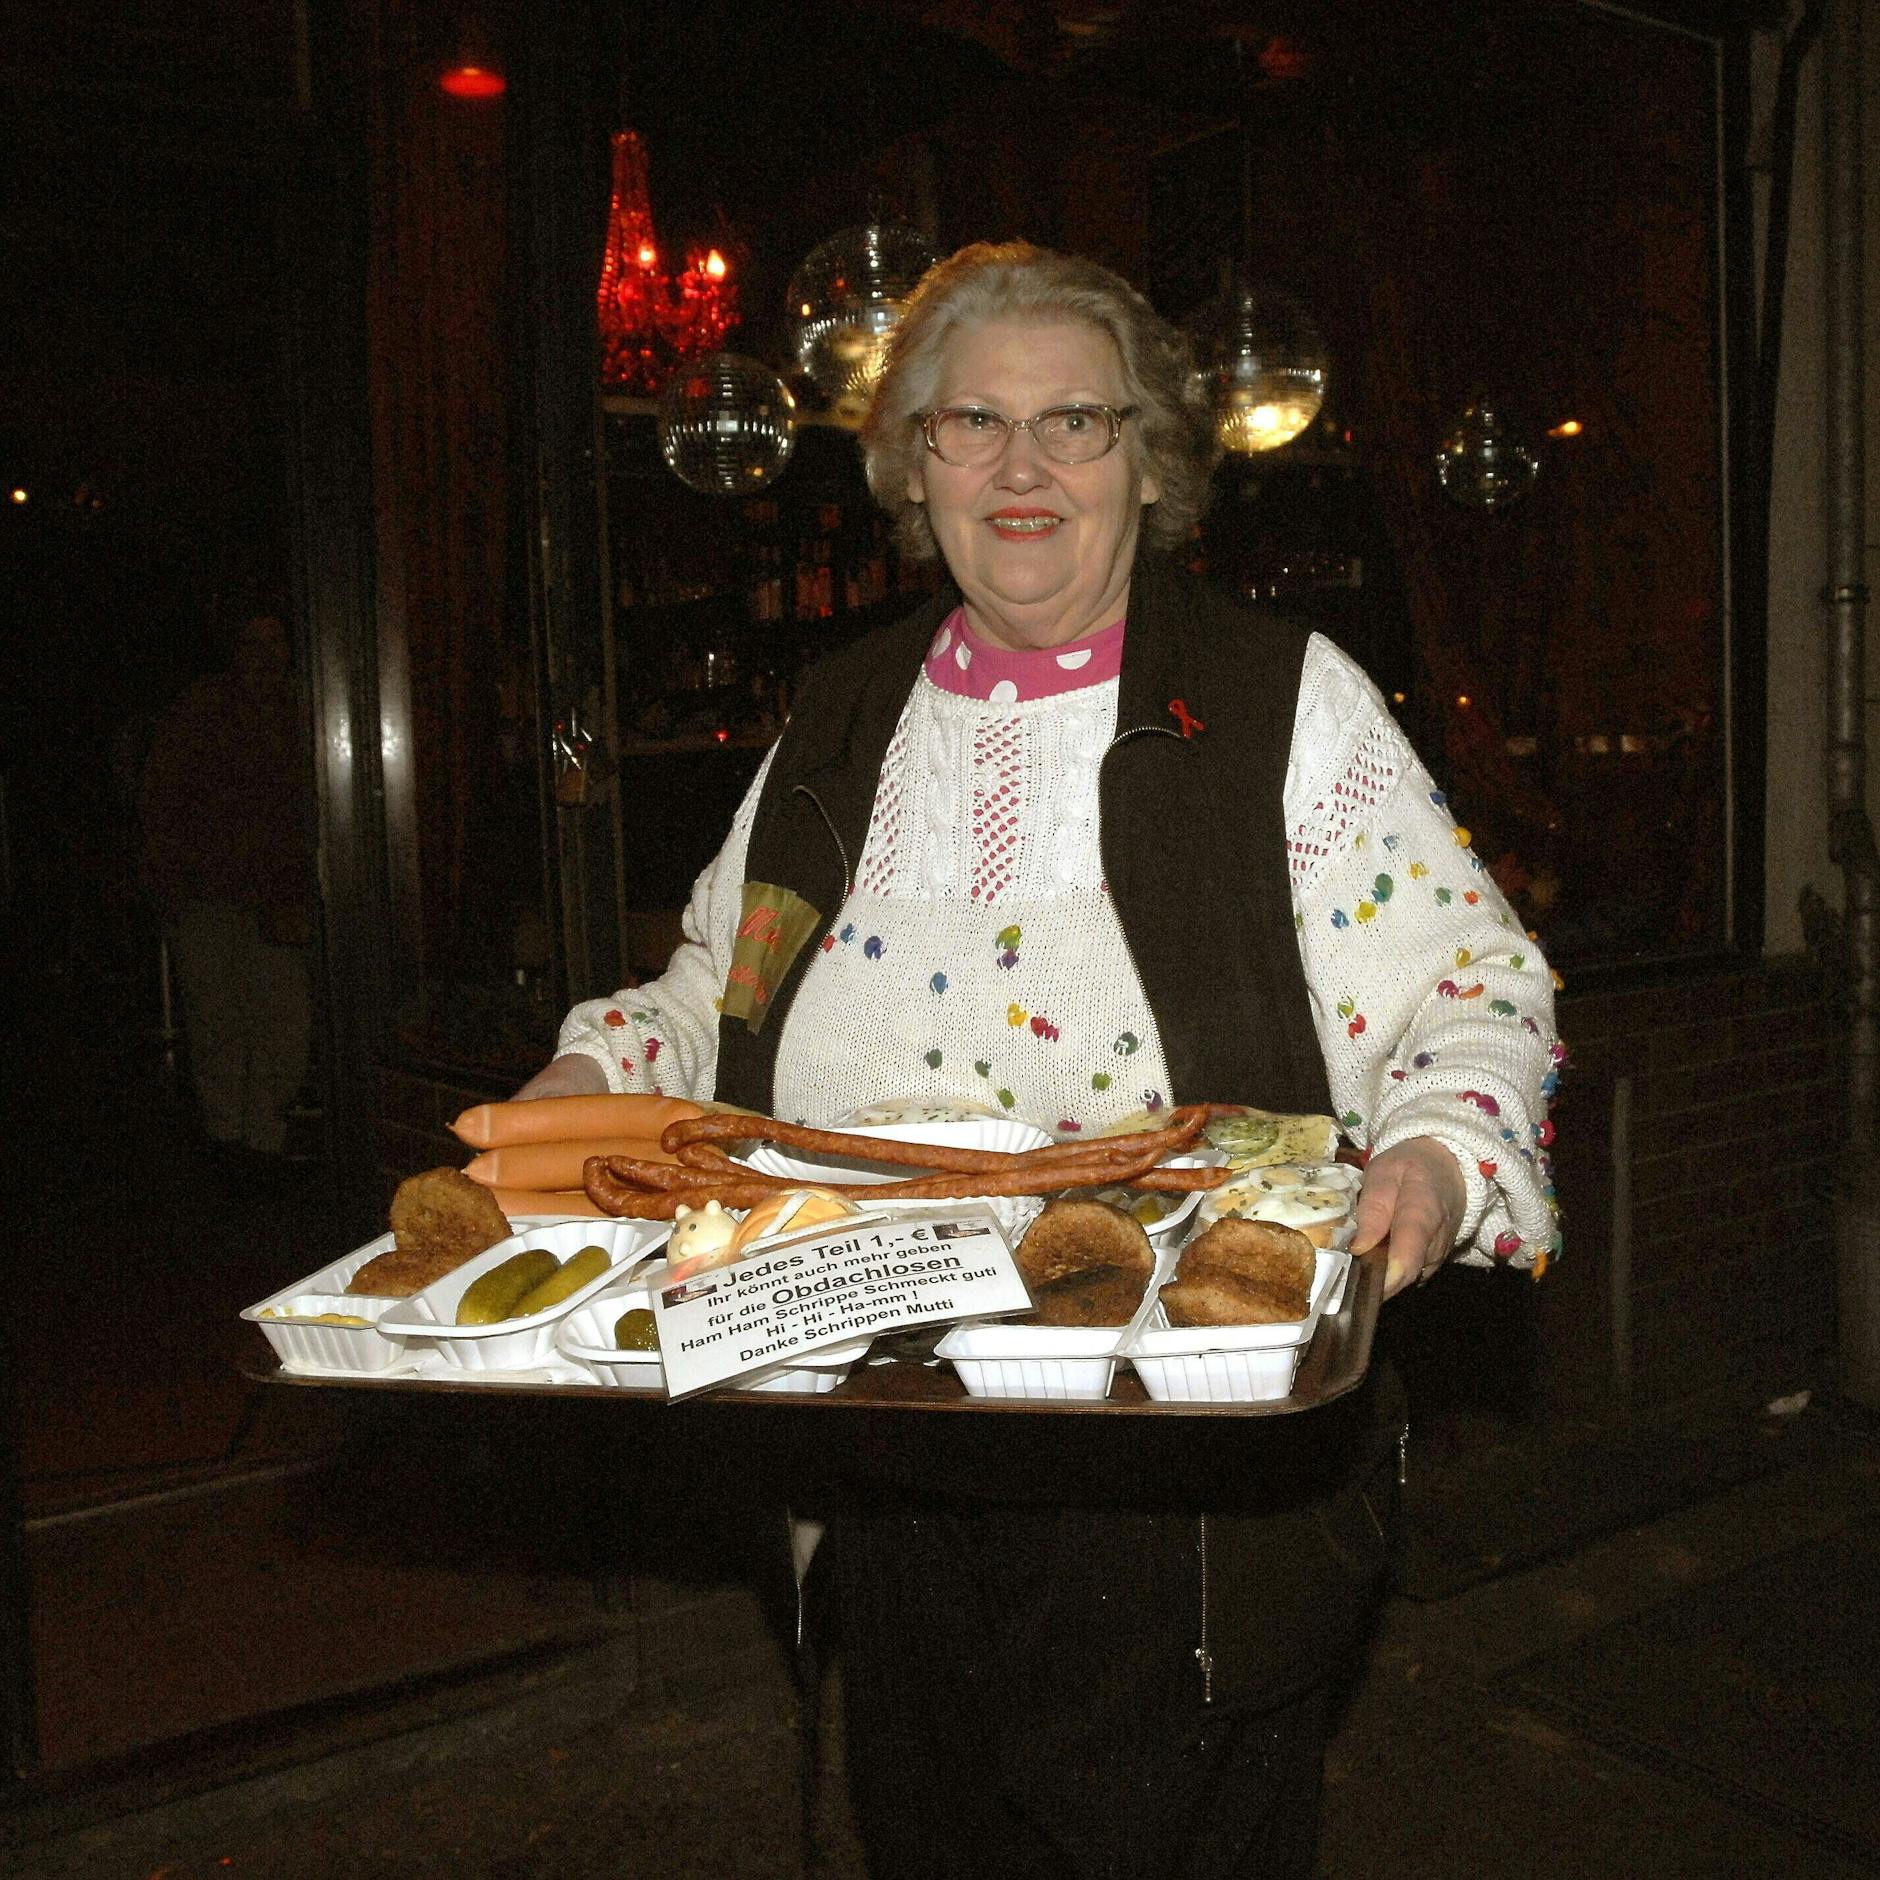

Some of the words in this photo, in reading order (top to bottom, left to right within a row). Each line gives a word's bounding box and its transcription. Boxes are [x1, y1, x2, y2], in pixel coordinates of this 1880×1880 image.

[707, 1293, 732, 1308] Ihr
[737, 1275, 790, 1299] könnt
[794, 1261, 838, 1280] auch
[844, 1250, 890, 1268] mehr
[896, 1243, 952, 1260] geben
[722, 1255, 804, 1288] Jedes
[811, 1238, 861, 1260] Teil
[911, 1228, 929, 1241] €
[680, 1331, 723, 1352] Ham
[728, 1316, 770, 1336] Ham
[775, 1290, 859, 1320] Schrippe
[864, 1270, 958, 1295] Schmeckt
[707, 1311, 734, 1327] für
[739, 1301, 767, 1317] die
[772, 1256, 963, 1306] Obdachlosen
[766, 1323, 786, 1338] Hi
[803, 1311, 823, 1326] Hi
[840, 1293, 907, 1315] Ha-mm
[912, 1290, 919, 1300] !
[739, 1335, 799, 1363] Danke
[804, 1306, 901, 1340] Schrippen
[906, 1299, 954, 1316] Mutti
